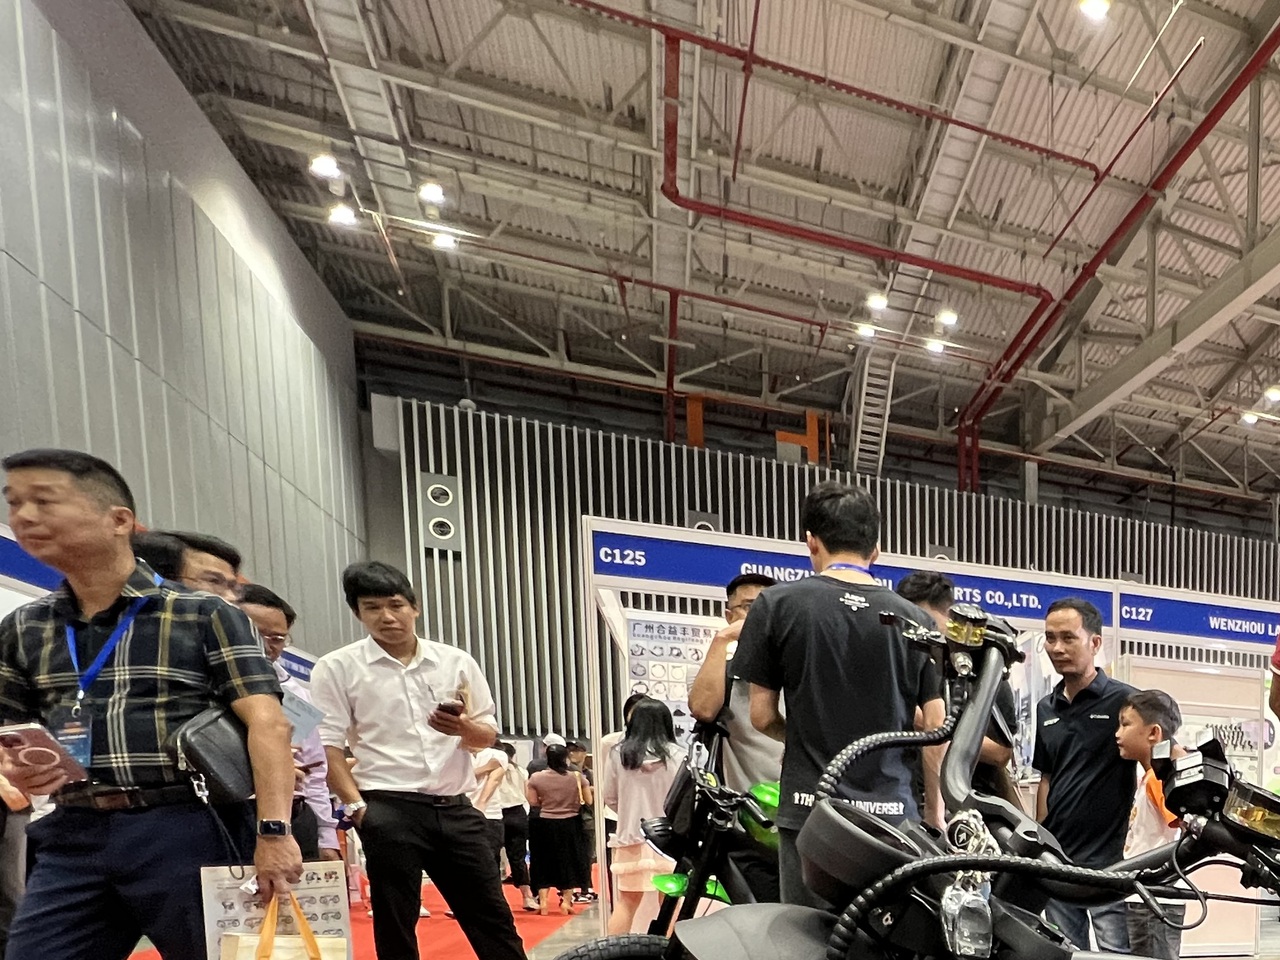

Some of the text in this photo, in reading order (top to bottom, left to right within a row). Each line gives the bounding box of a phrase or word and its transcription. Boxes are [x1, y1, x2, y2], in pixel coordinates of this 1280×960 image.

[599, 547, 647, 566] C125
[985, 590, 1042, 609] CO.,LTD.
[1121, 606, 1153, 621] C127
[1209, 616, 1265, 635] WENZHOU
